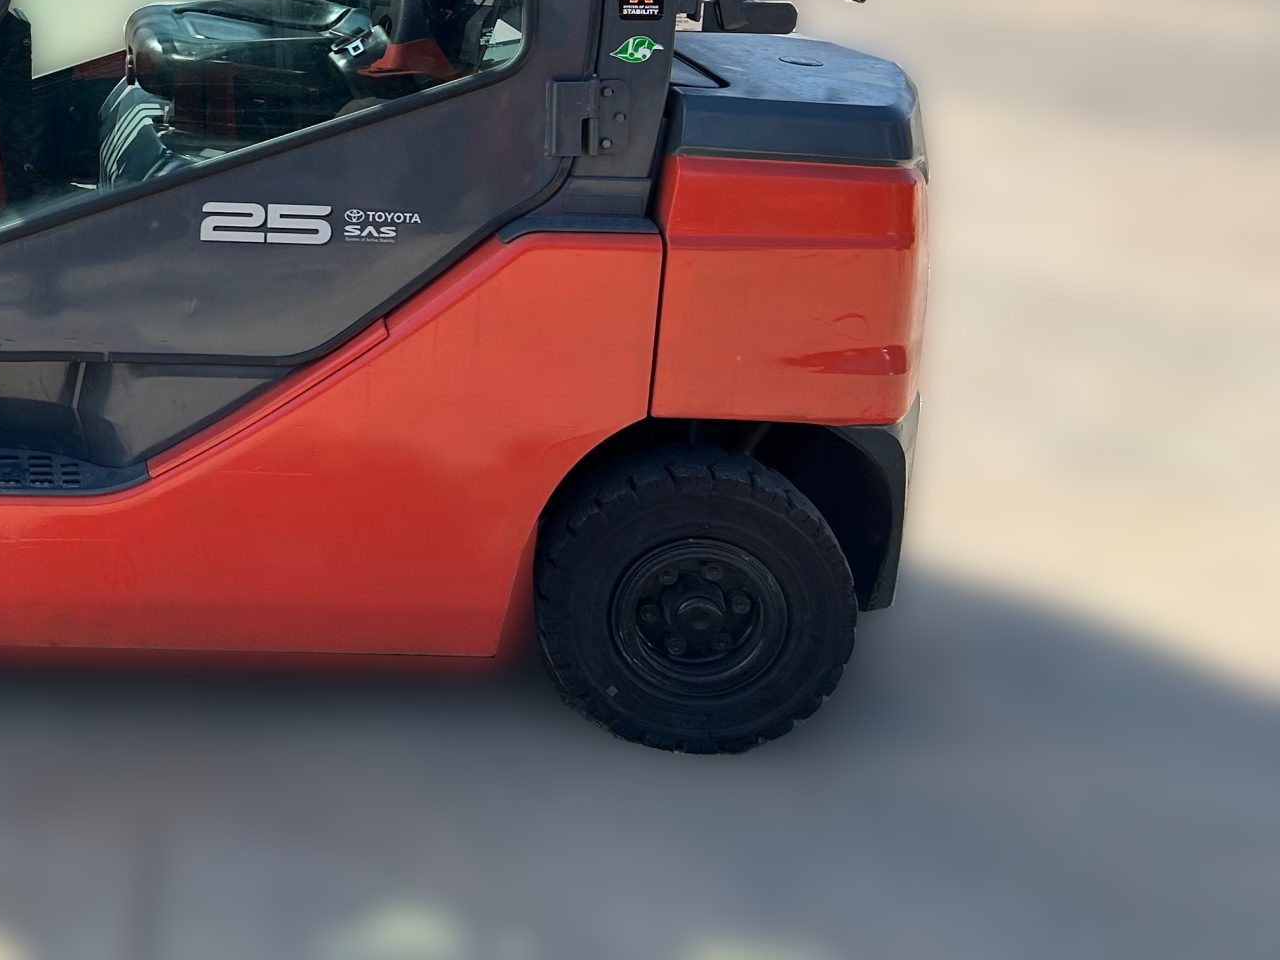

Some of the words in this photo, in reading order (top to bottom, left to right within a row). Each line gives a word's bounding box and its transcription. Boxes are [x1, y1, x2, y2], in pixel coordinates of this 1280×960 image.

[200, 201, 332, 245] 25
[367, 211, 421, 224] TOYOTA
[343, 225, 397, 238] SAS
